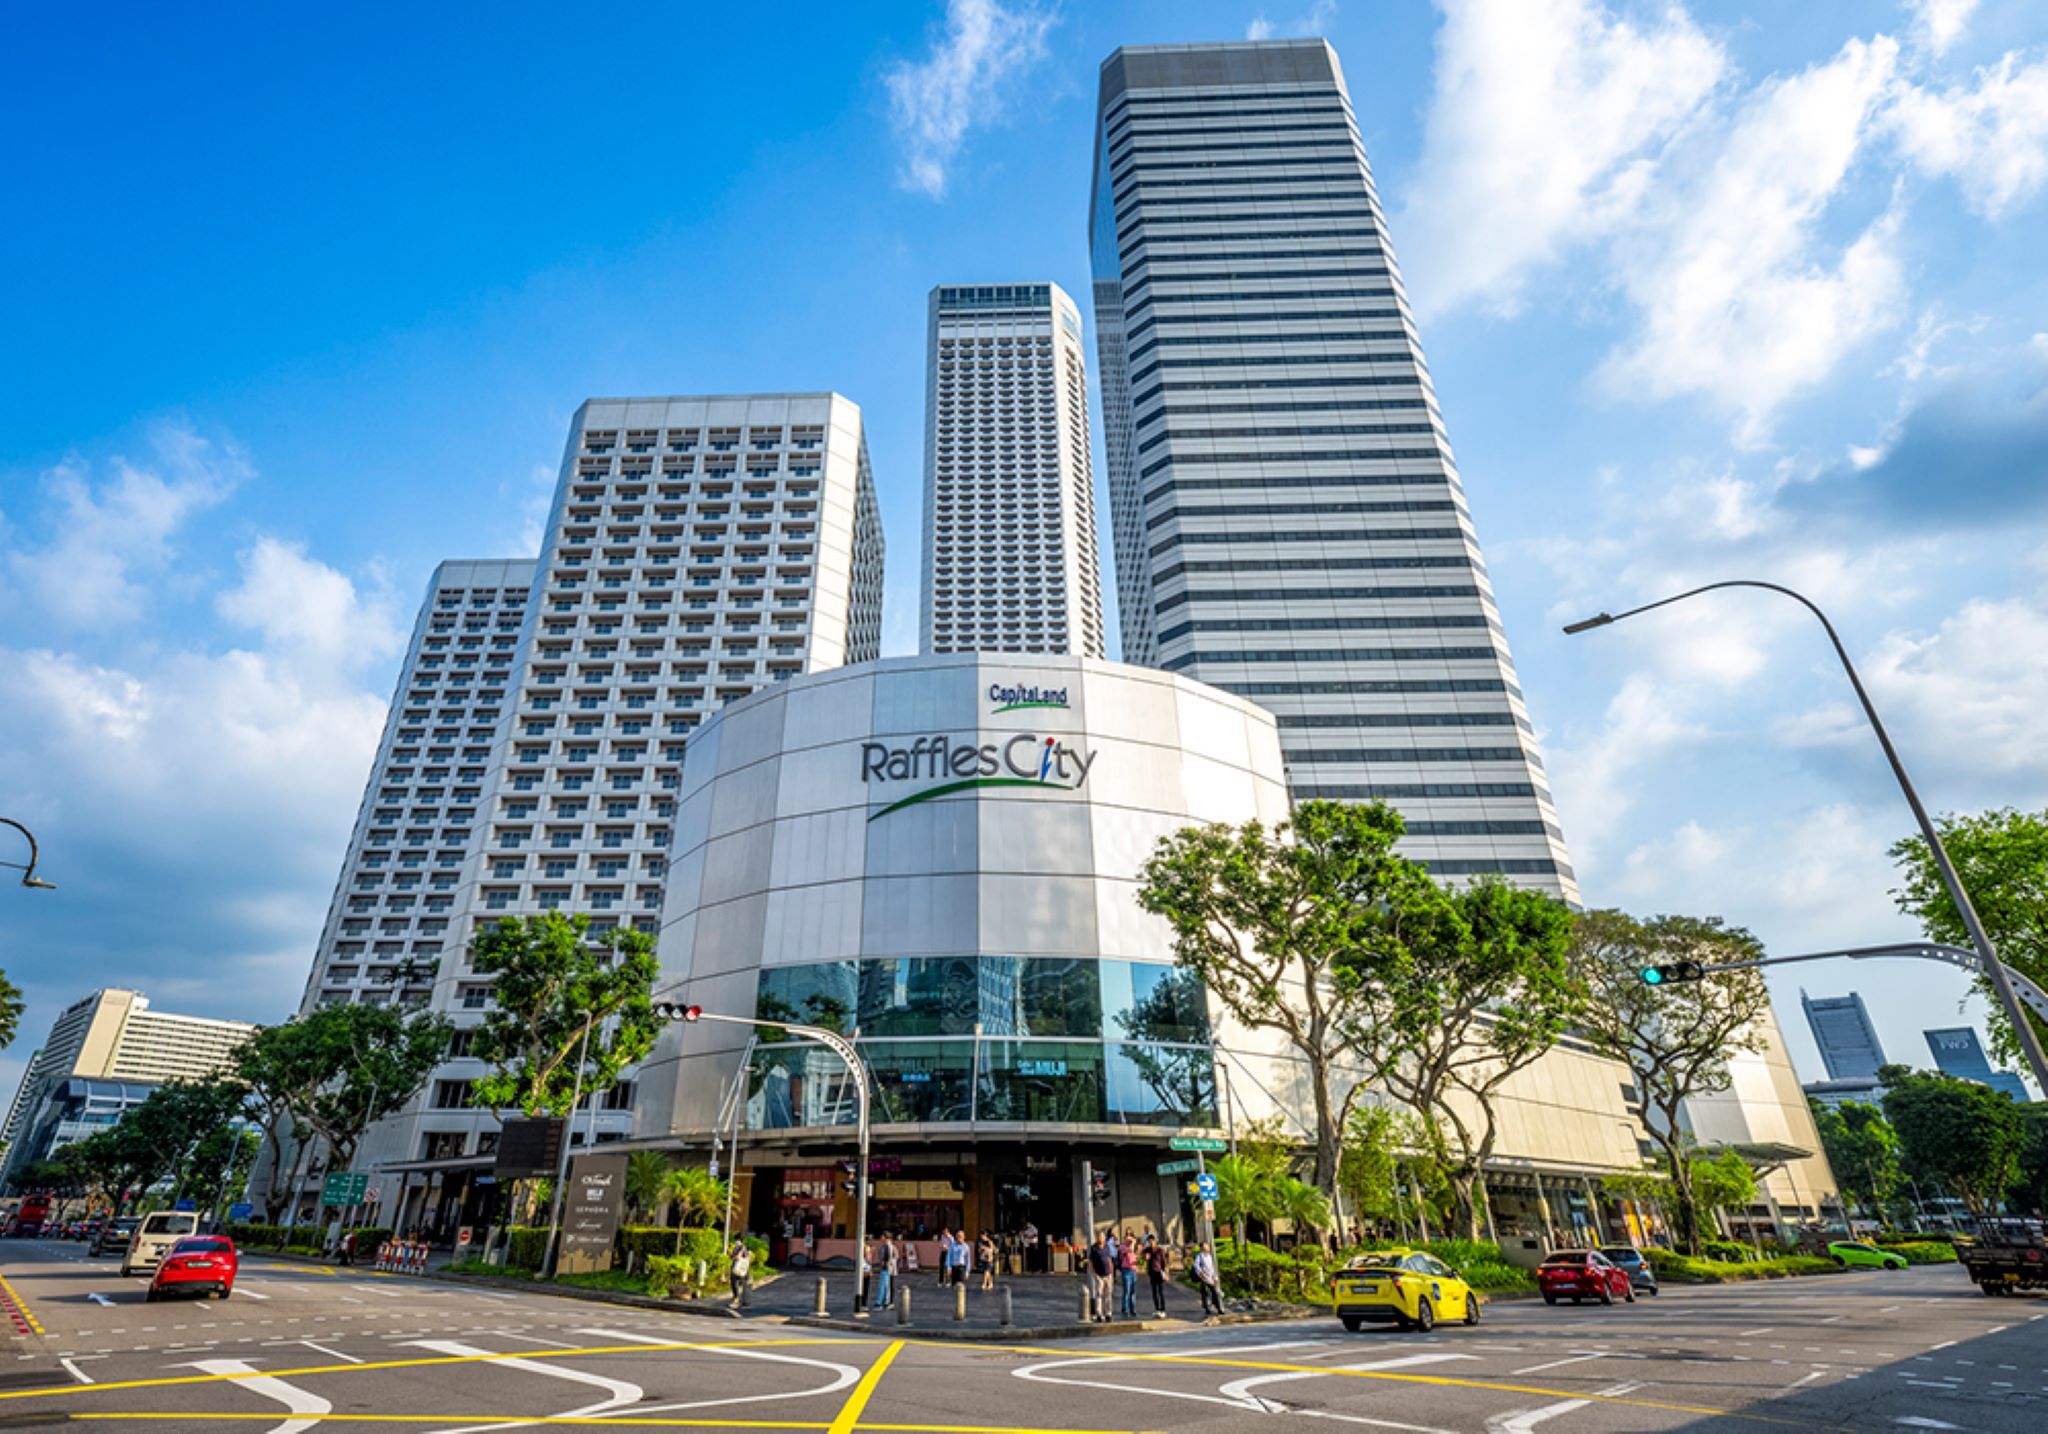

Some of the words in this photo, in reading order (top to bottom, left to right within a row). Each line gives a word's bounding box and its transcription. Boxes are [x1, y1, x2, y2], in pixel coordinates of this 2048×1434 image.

[990, 683, 1067, 704] CapitaLand
[860, 736, 999, 782] Raffles
[1004, 734, 1097, 788] City
